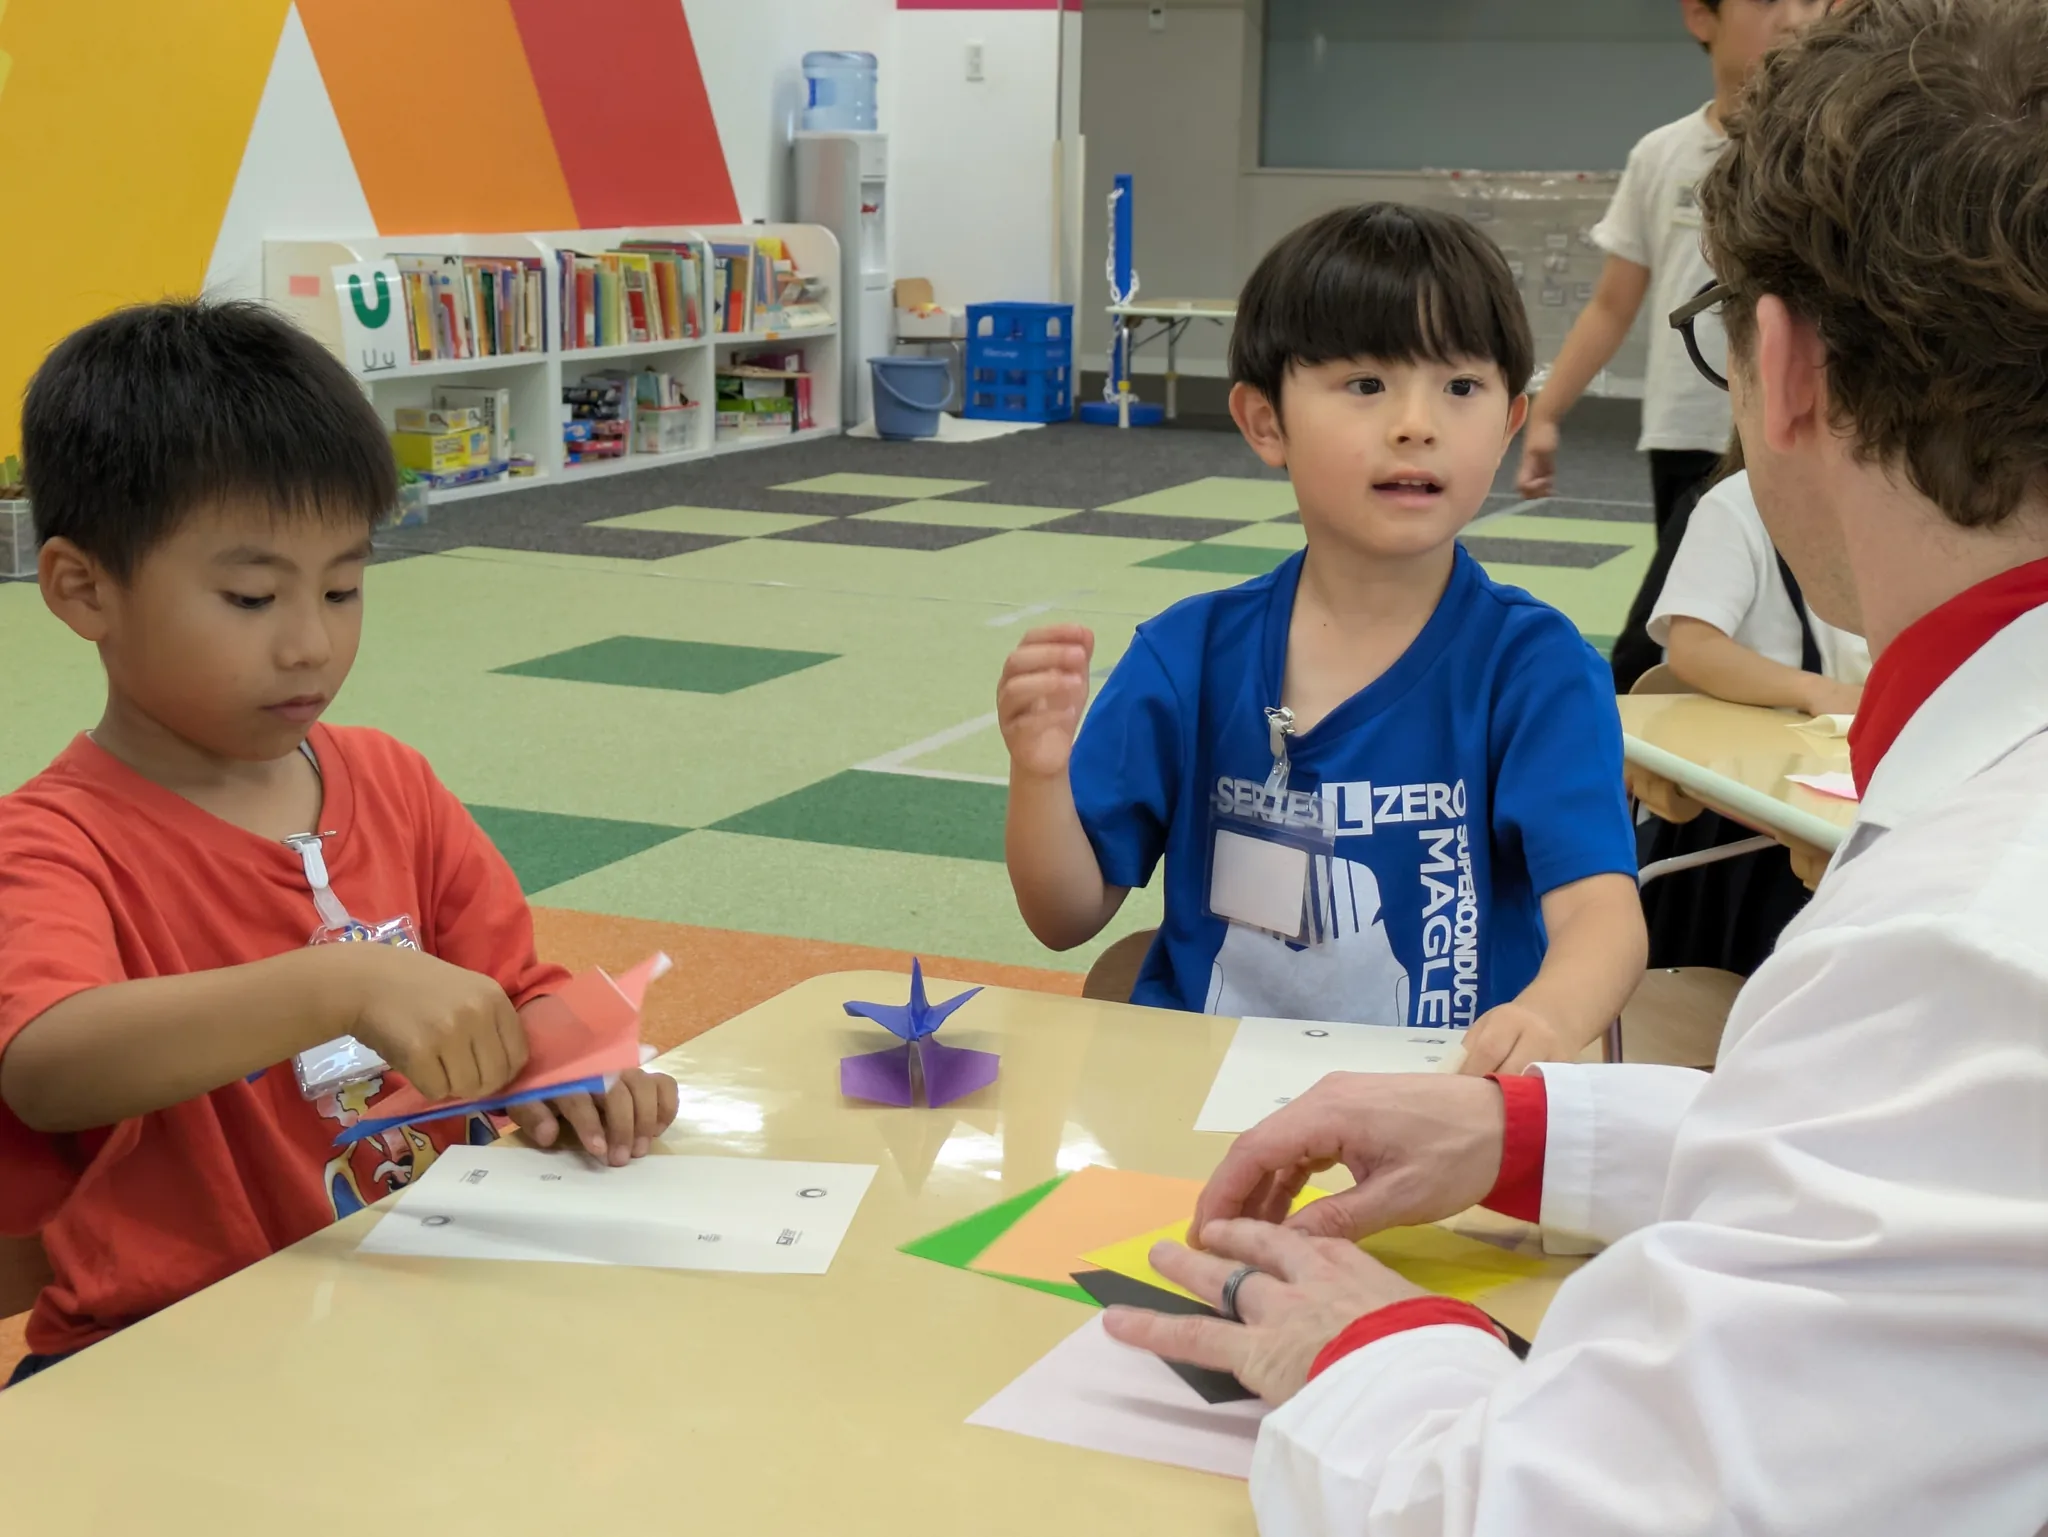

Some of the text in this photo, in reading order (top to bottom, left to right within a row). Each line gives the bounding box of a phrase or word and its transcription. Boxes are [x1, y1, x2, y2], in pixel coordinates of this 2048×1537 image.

[348, 271, 391, 329] U
[1332, 783, 1368, 832] L
[1373, 778, 1466, 824] ZERO
[1416, 828, 1455, 1029] MAGLE
[1453, 824, 1478, 1029] SUPERCONDUCT
